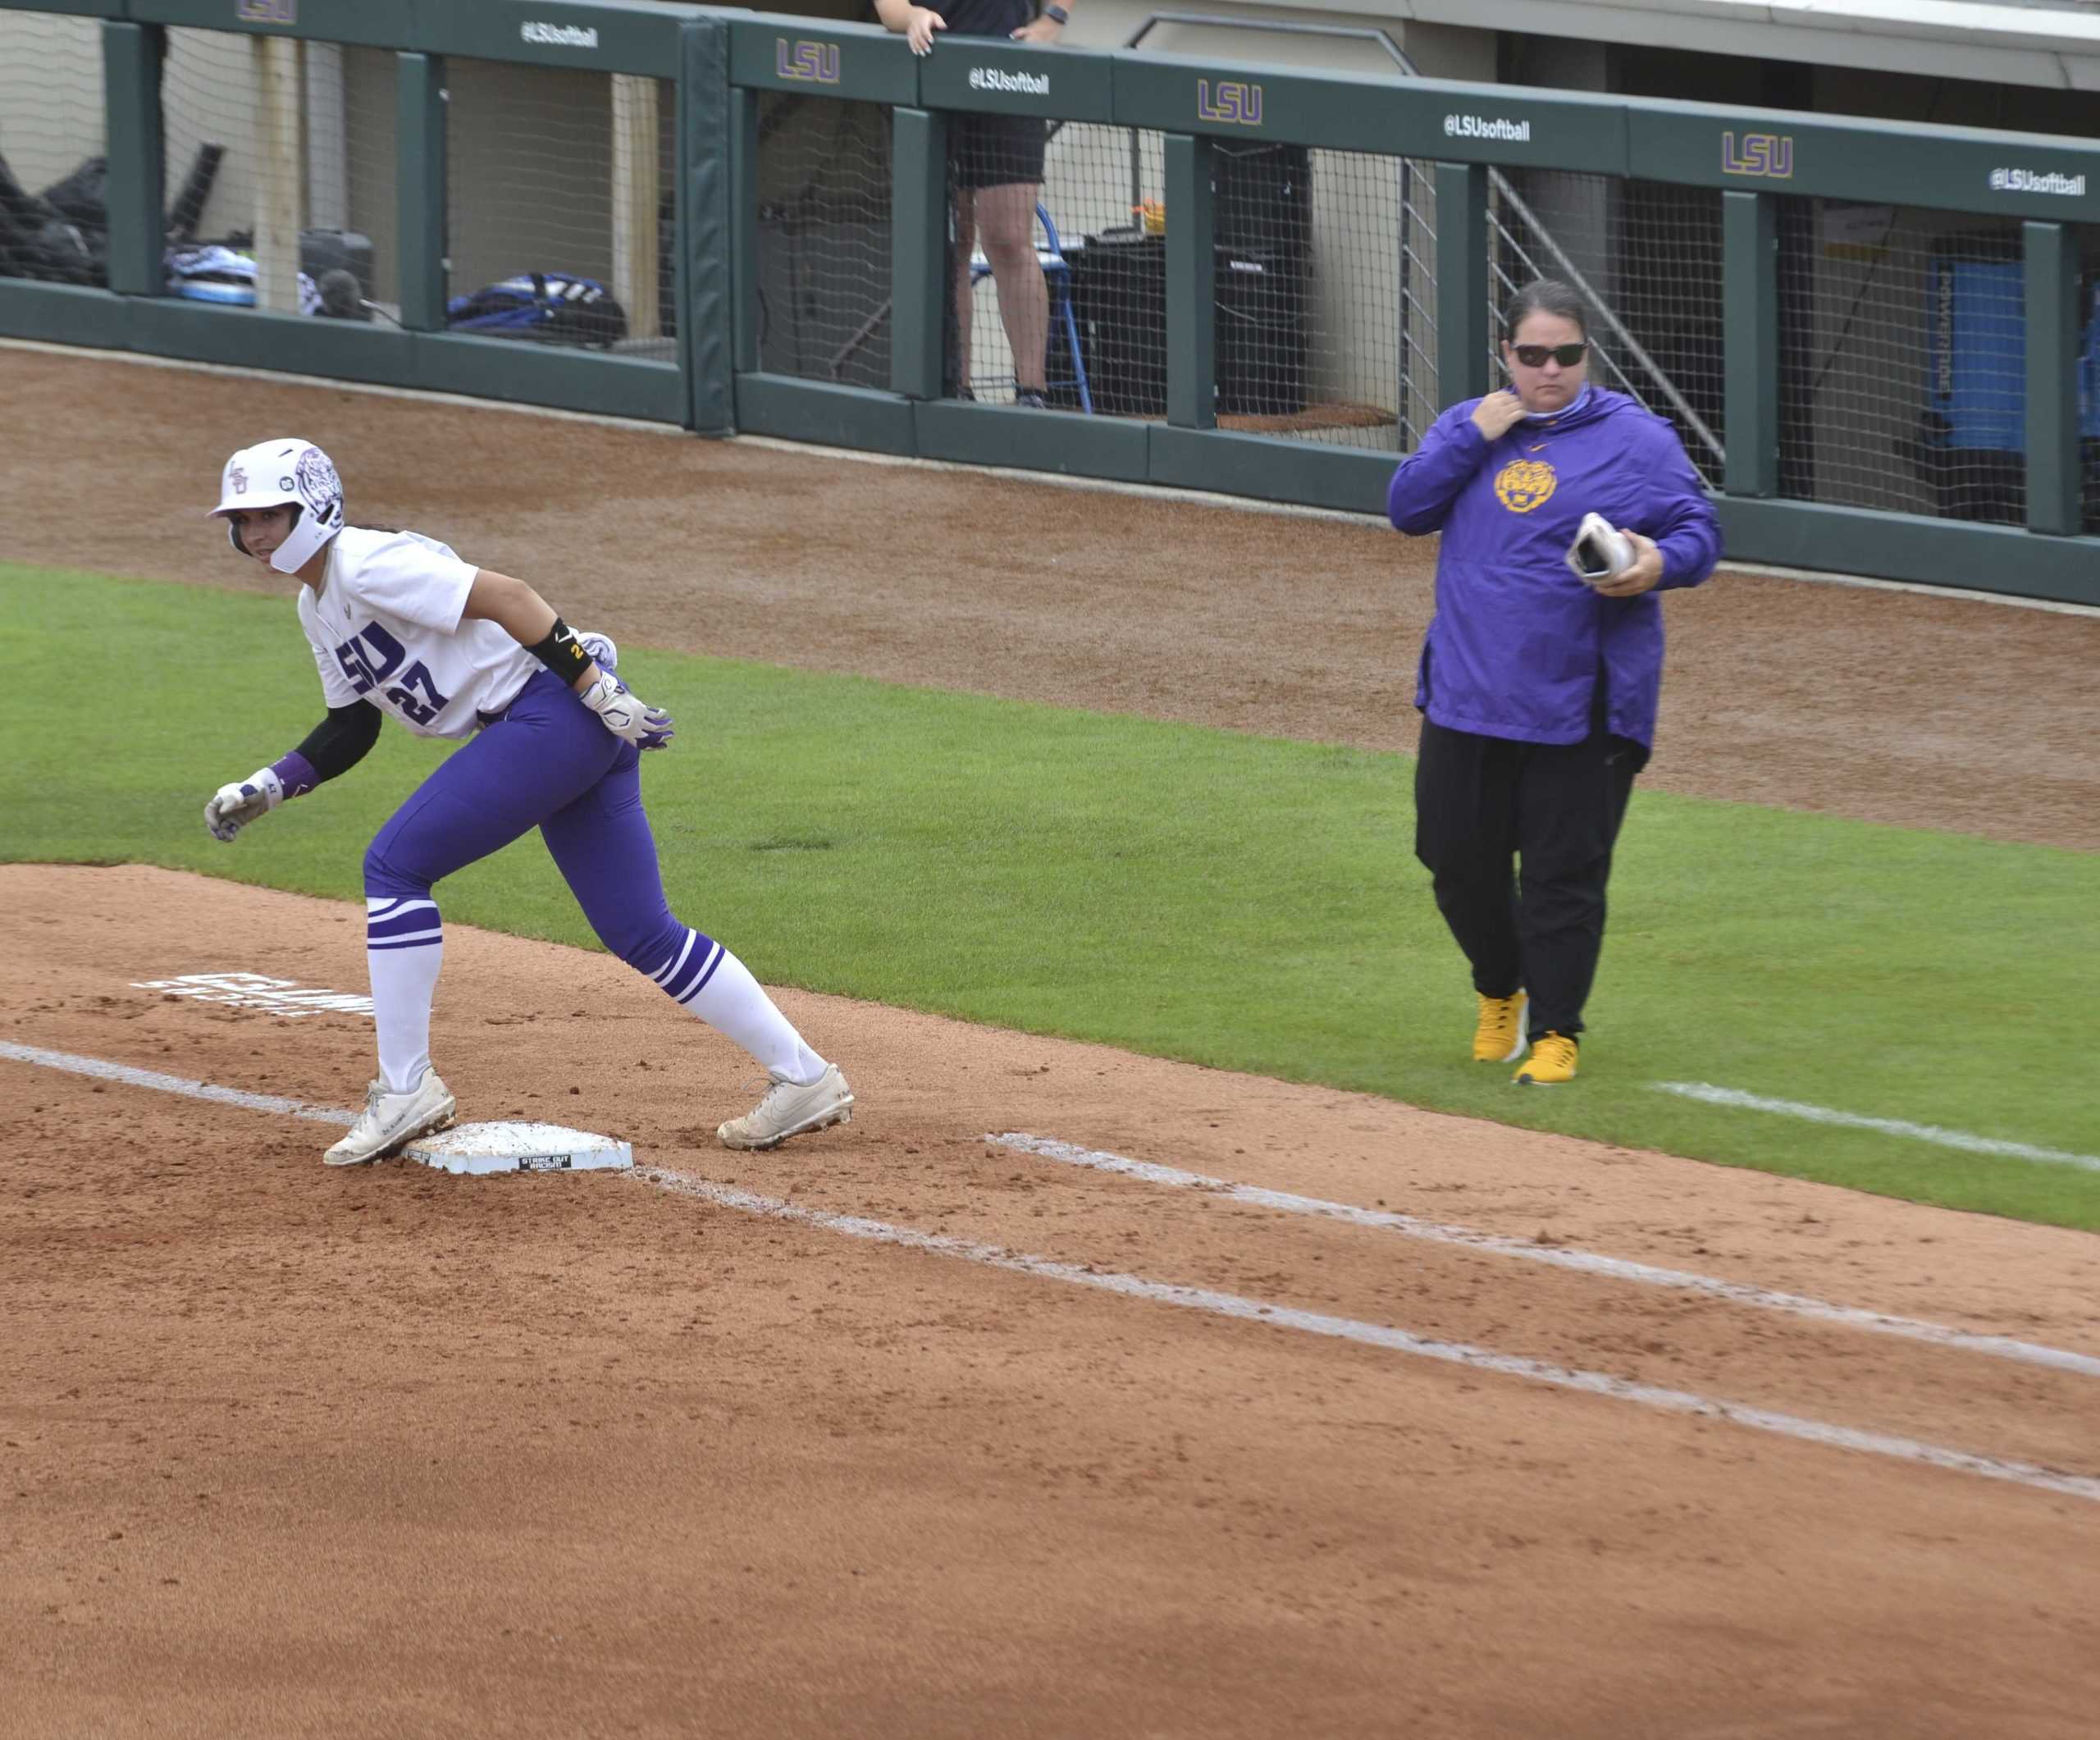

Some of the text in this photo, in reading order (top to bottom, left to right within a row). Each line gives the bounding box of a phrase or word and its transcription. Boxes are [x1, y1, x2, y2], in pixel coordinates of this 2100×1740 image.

[775, 38, 840, 84] LSU
[969, 67, 1049, 94] @LSUsoftball
[1198, 79, 1262, 126] LSU
[1444, 114, 1529, 141] @LSUsoftball
[1723, 131, 1793, 178] LSU
[1988, 167, 2085, 196] @LSUsoftball
[386, 660, 450, 726] 27
